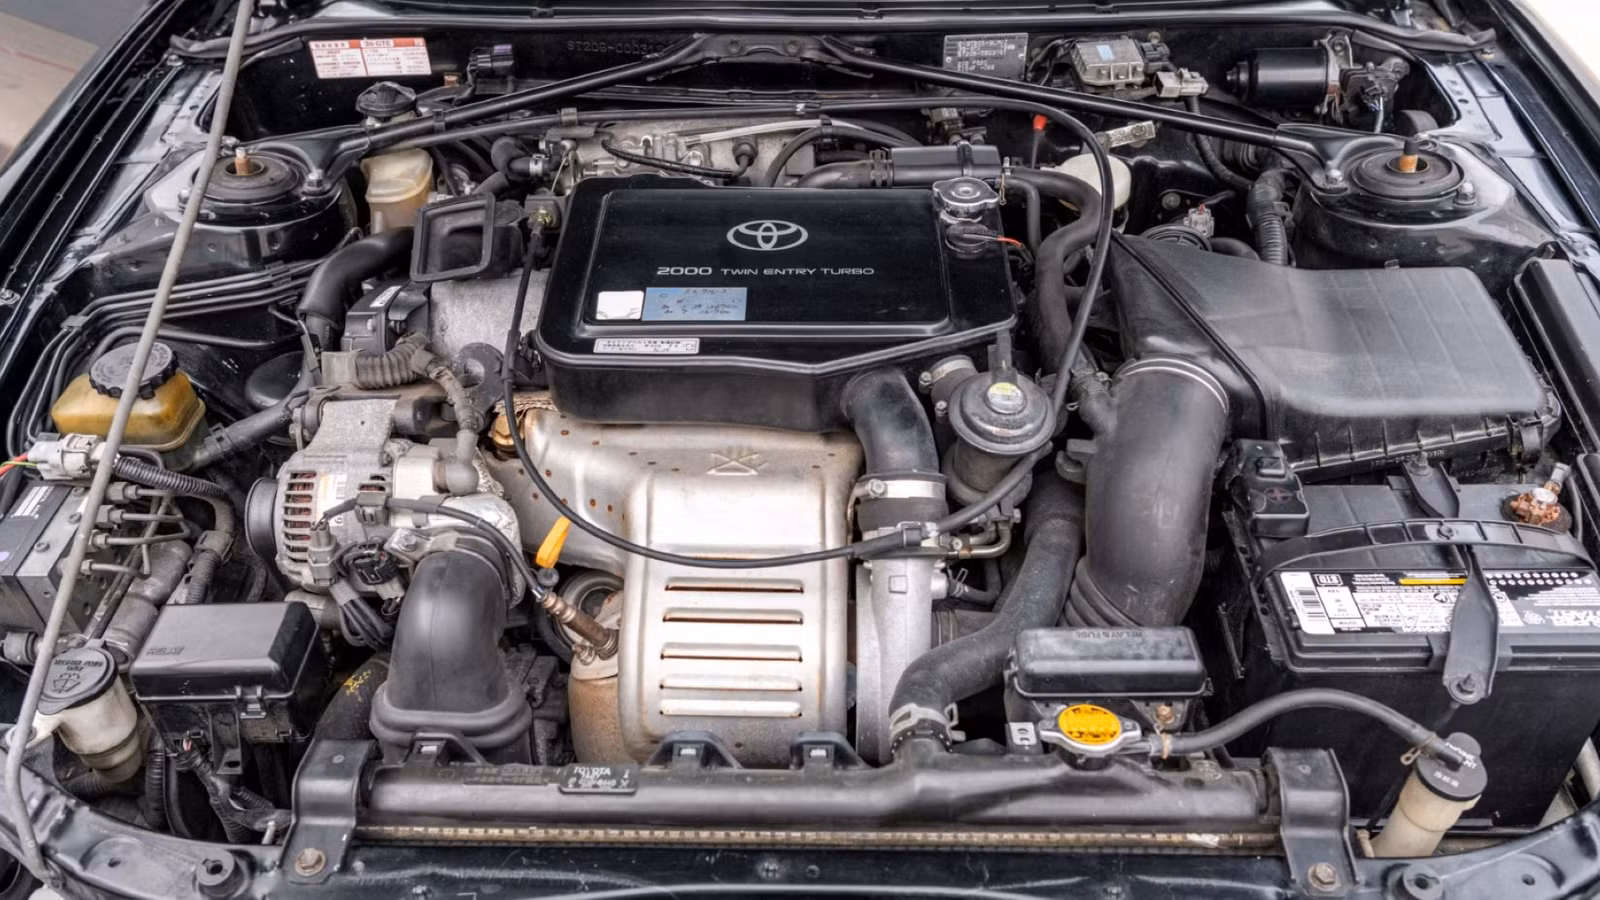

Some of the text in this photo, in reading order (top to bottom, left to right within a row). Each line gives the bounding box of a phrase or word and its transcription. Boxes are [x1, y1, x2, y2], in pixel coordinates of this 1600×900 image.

[656, 266, 712, 275] 2000
[820, 267, 875, 275] TURBO
[573, 766, 611, 776] TOYOTA
